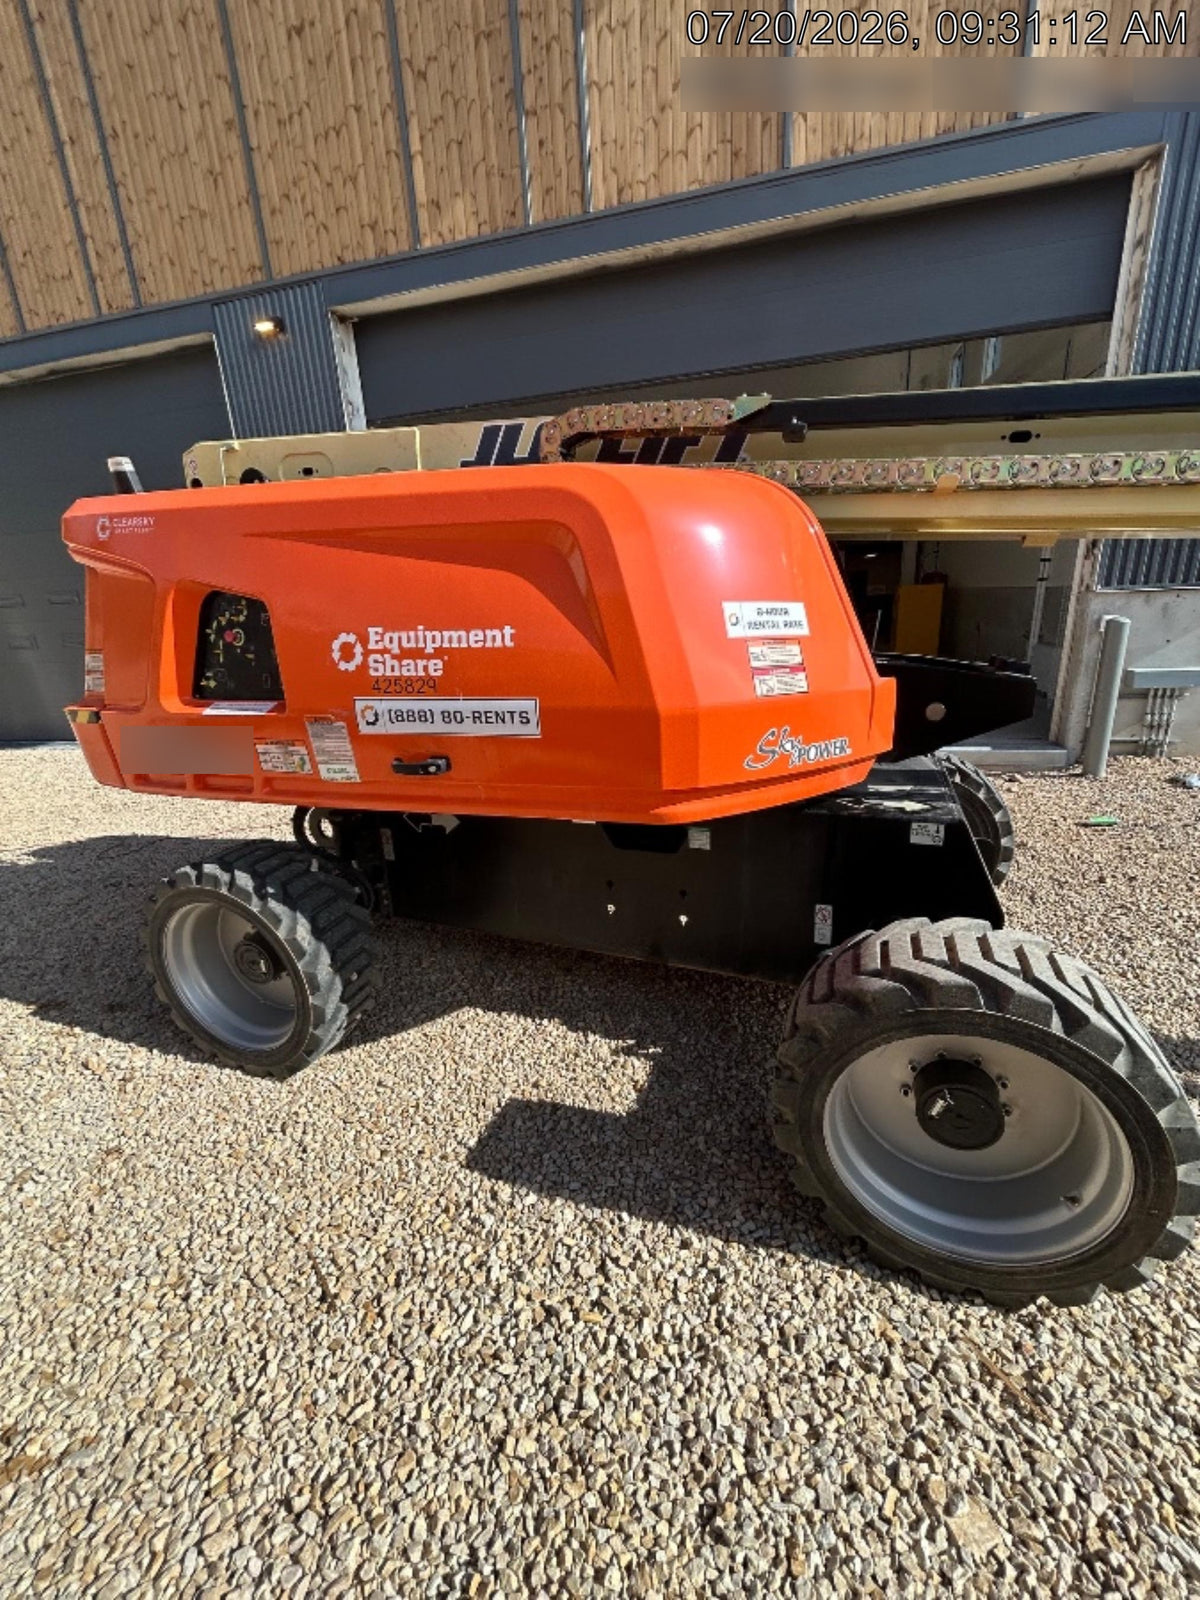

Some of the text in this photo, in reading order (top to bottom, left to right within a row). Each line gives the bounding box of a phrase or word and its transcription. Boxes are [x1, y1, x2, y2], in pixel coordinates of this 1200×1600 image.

[367, 625, 516, 654] Equipment
[367, 654, 444, 677] Share
[371, 678, 438, 694] 425829
[388, 708, 531, 725] (888) 80-RENTS
